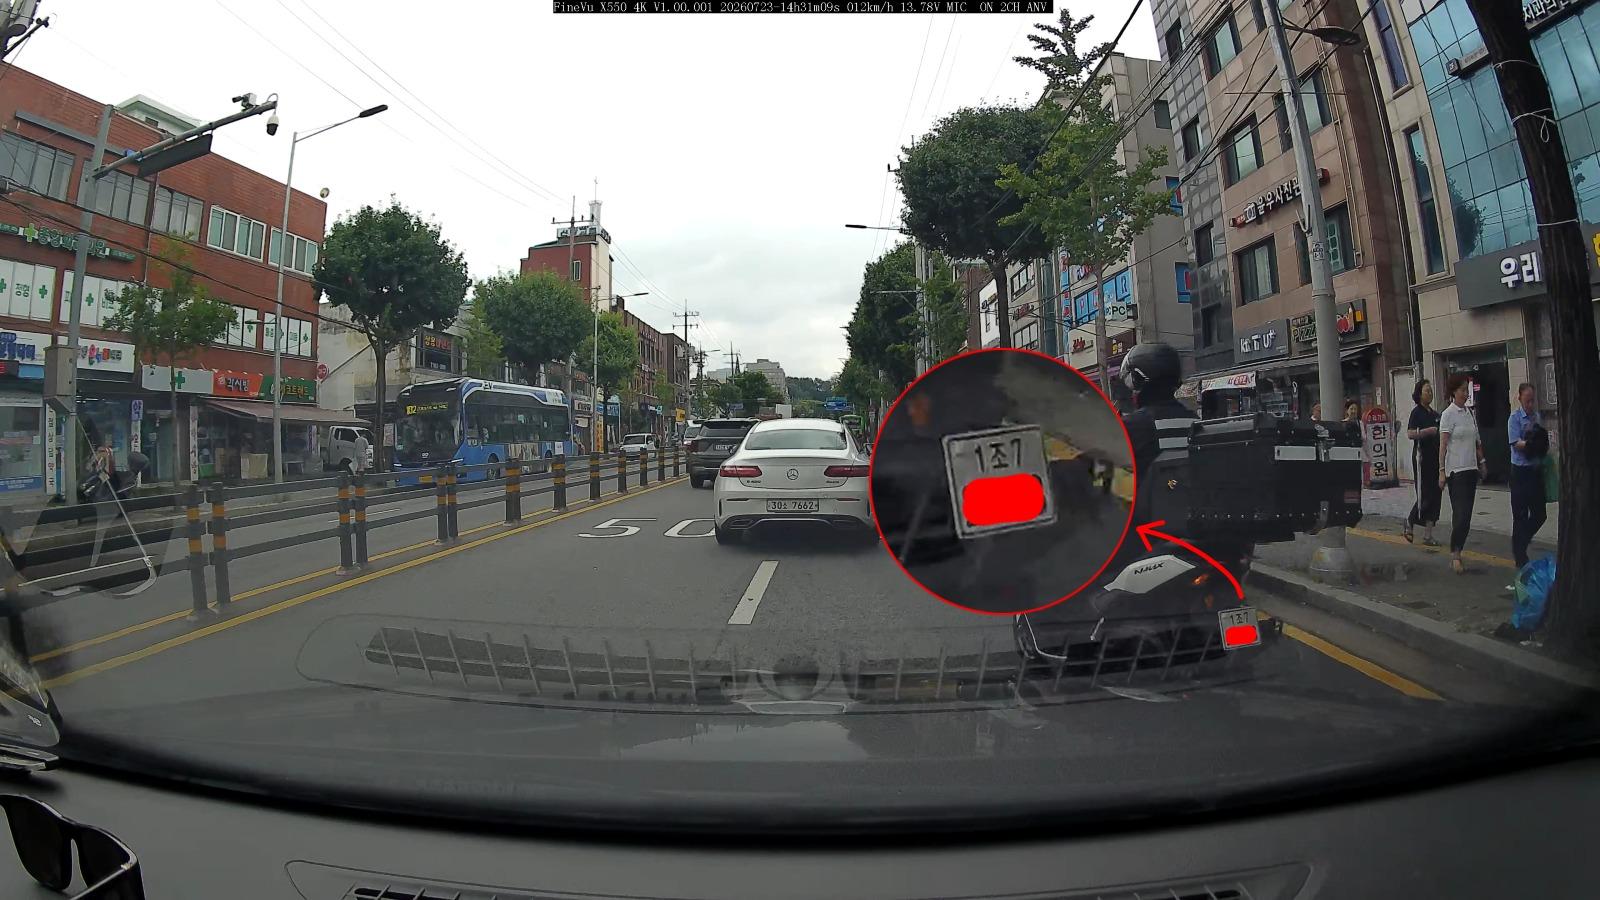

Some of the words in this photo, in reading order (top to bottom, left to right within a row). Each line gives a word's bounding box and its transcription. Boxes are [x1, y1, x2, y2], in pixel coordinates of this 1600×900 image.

[1501, 252, 1541, 288] 우리
[1112, 305, 1126, 315] PC
[974, 438, 1023, 472] 1조7
[1370, 425, 1389, 478] 한의원
[791, 501, 814, 510] 7662
[1230, 611, 1249, 625] 1조7
